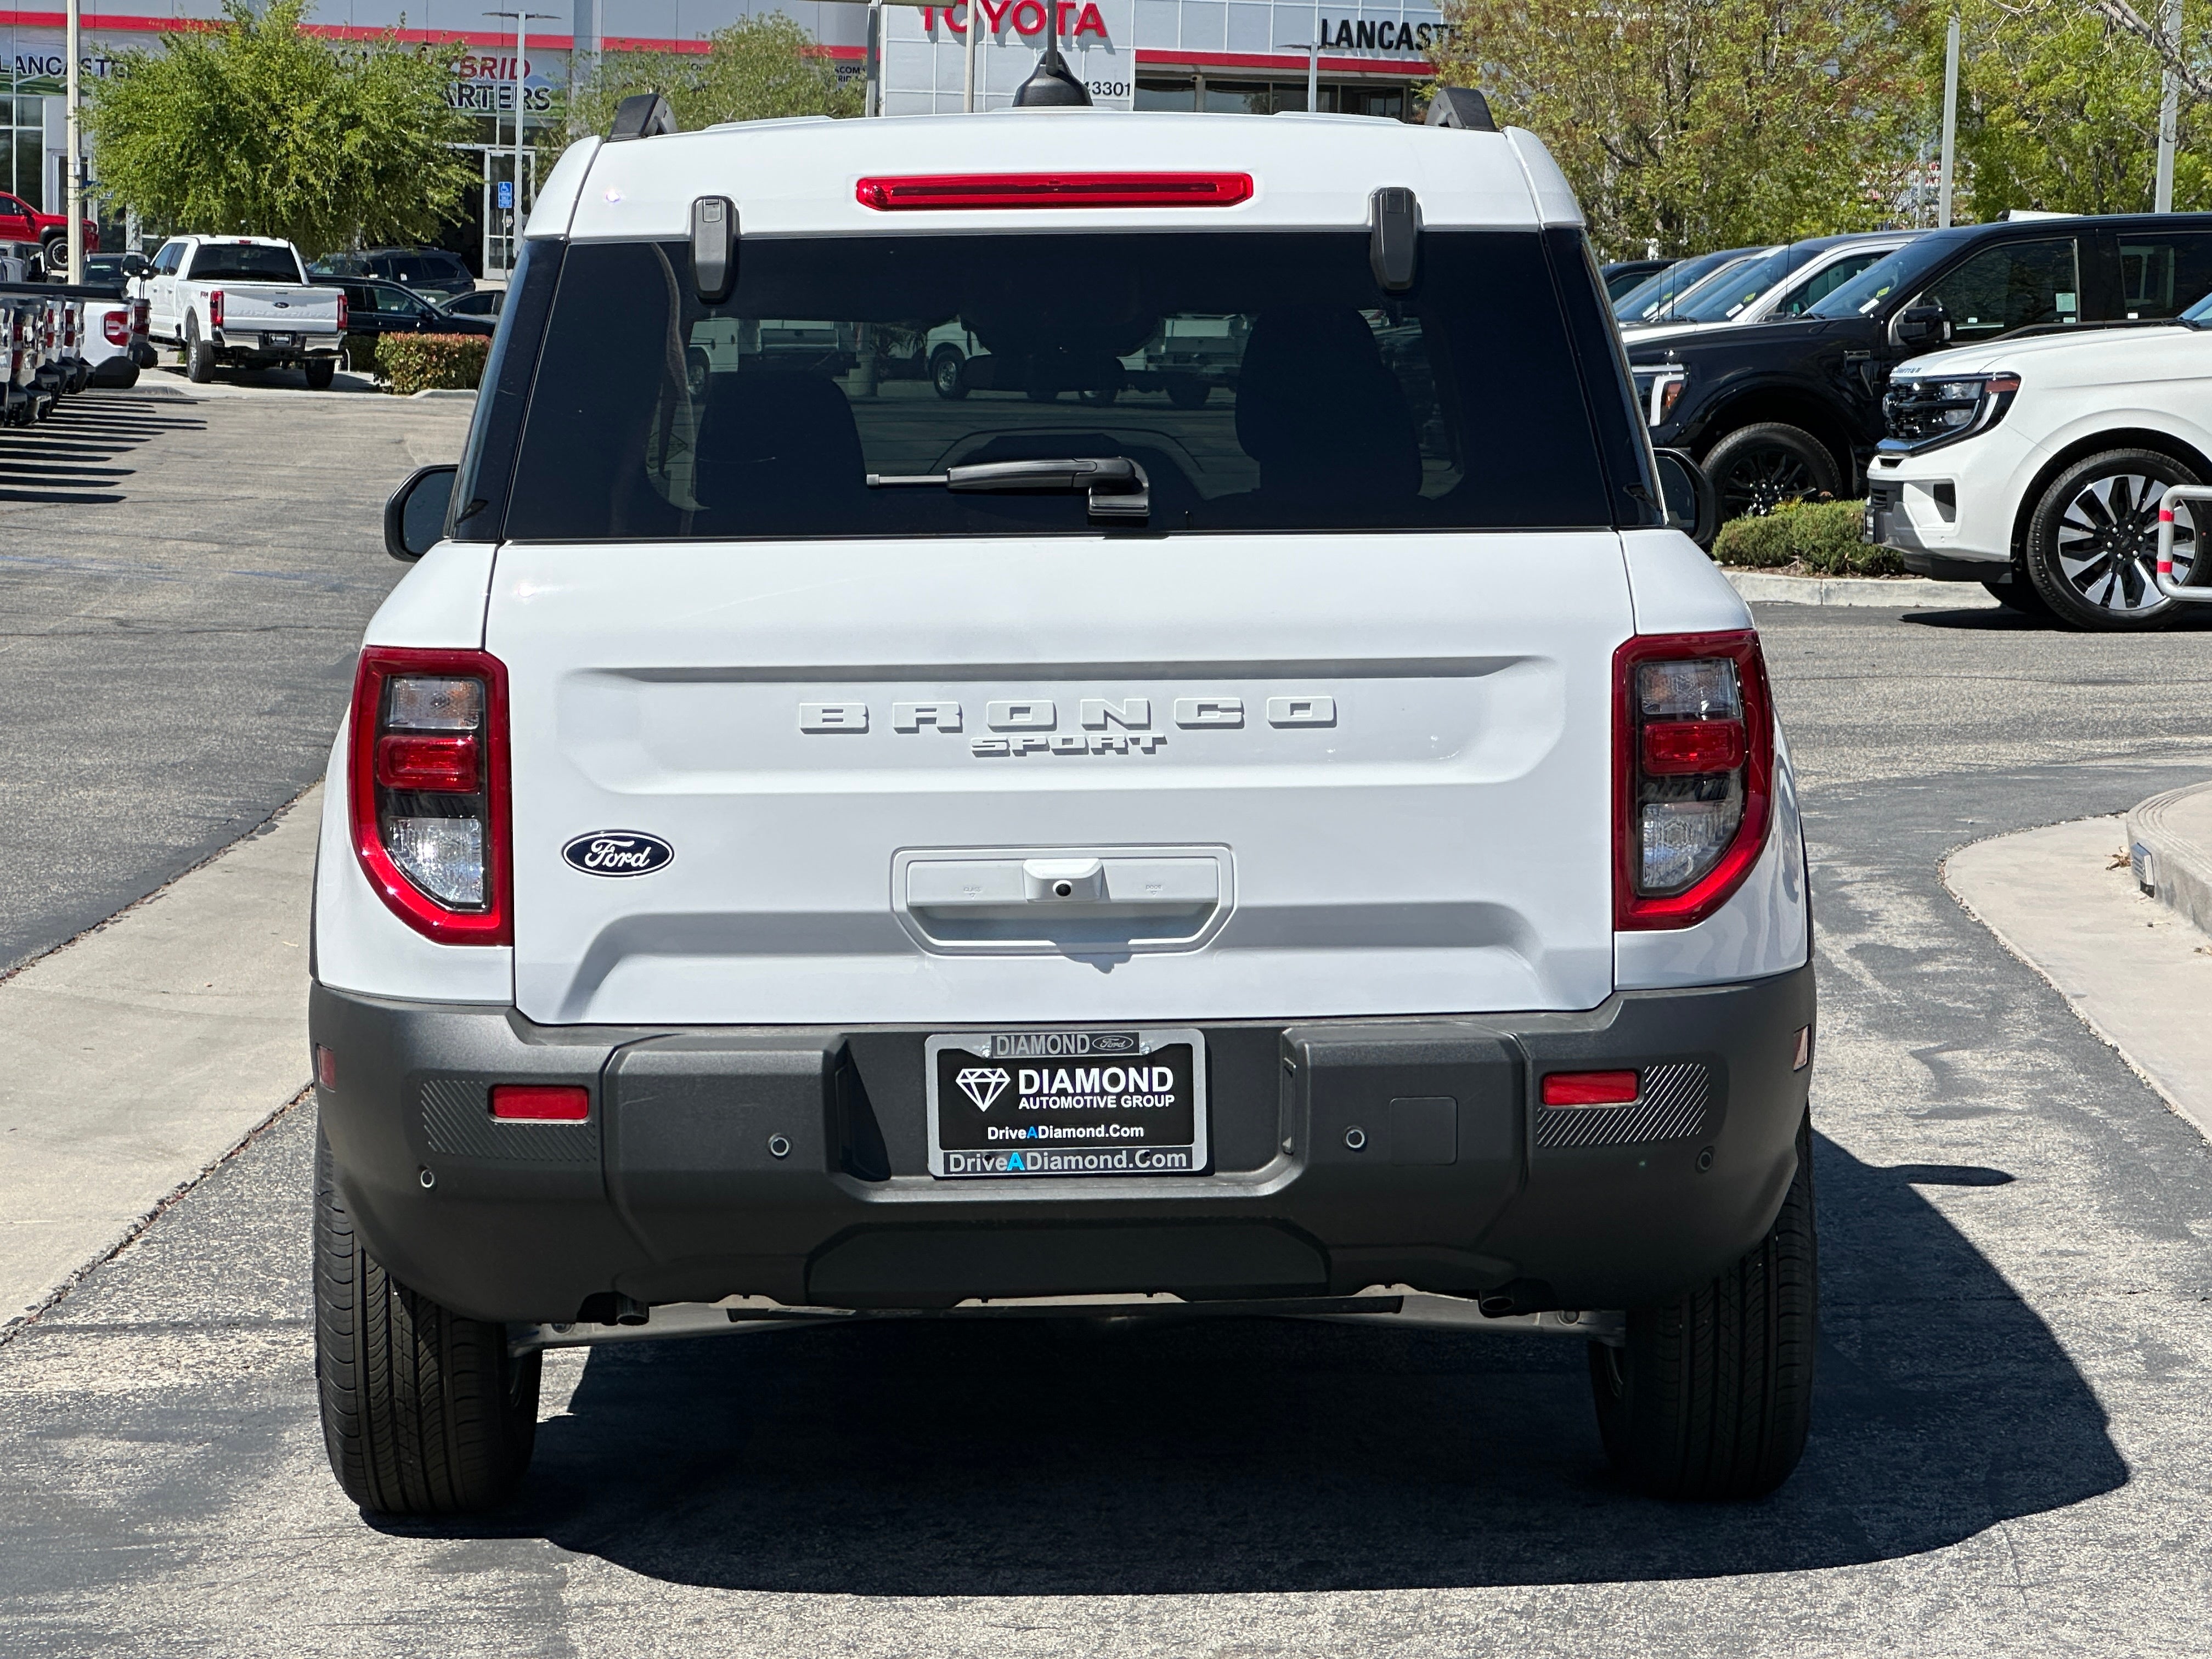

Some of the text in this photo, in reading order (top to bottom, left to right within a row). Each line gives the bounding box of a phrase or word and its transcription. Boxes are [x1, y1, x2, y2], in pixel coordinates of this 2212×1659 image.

[799, 696, 1337, 735] BRONCO
[970, 734, 1167, 758] SPORT
[584, 839, 652, 867] Ford
[996, 1034, 1127, 1056] DIAMOND Ford
[1018, 1066, 1174, 1094] DIAMOND
[1018, 1094, 1175, 1110] AUTOMOTIVE GROUP
[988, 1124, 1144, 1140] DriveADiamond.Com
[949, 1150, 1187, 1172] DriveADiamond.Com
